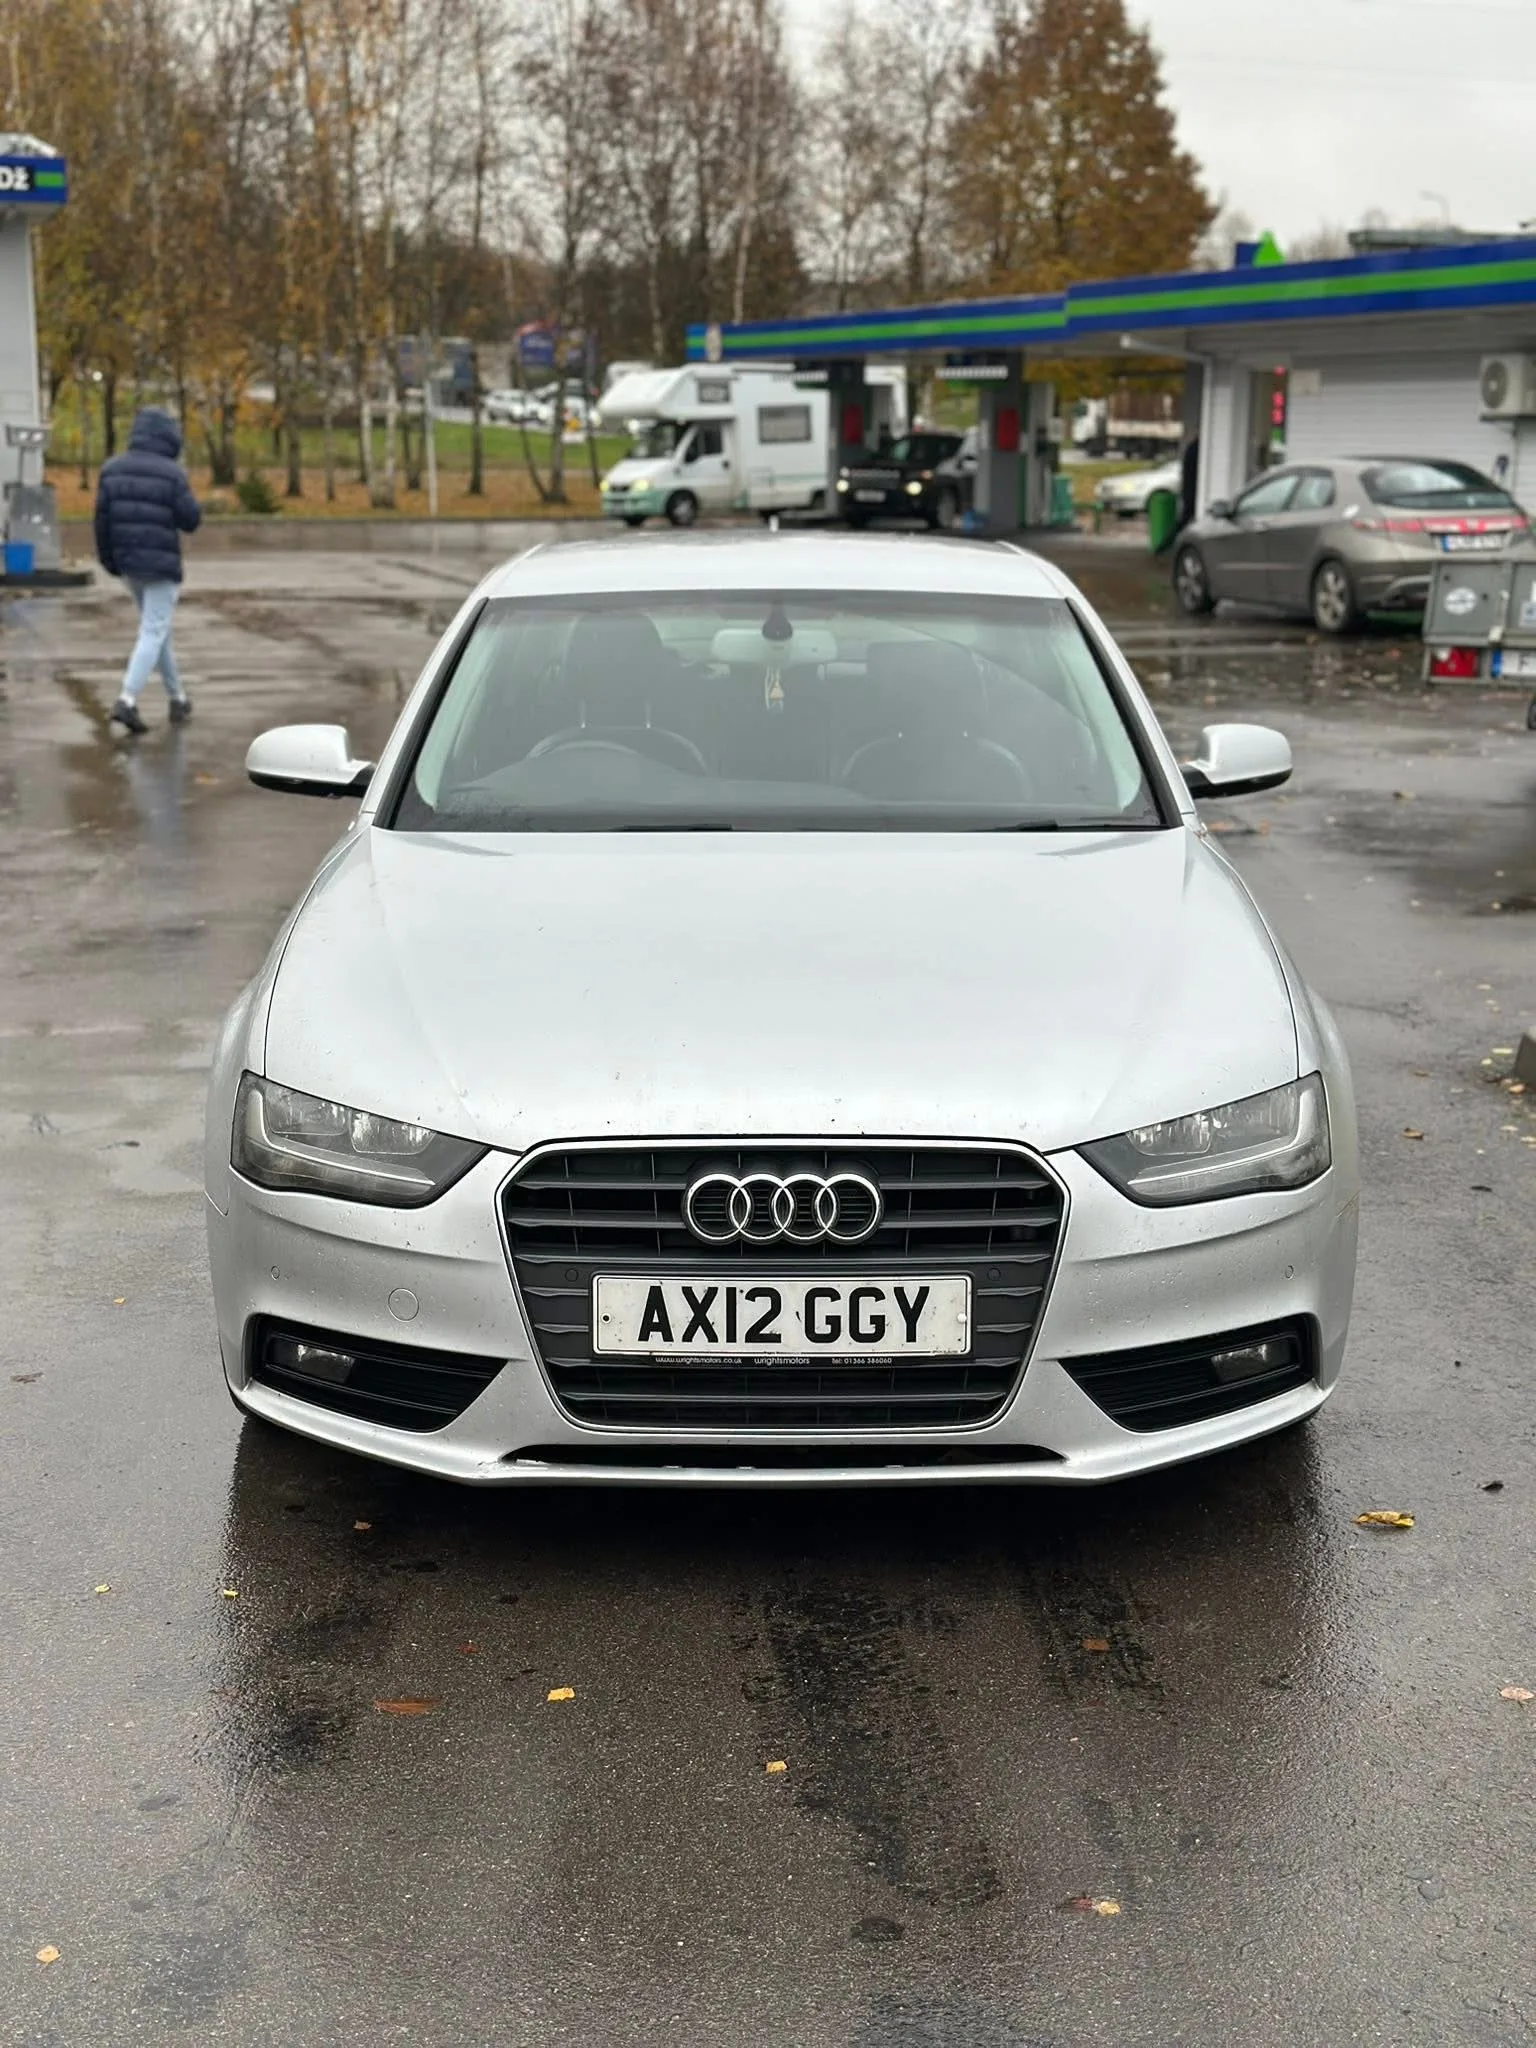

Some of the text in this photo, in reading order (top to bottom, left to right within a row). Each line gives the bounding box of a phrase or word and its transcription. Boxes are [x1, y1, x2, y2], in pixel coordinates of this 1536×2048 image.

[637, 1285, 931, 1344] AX12 GGY
[655, 1356, 742, 1365] www.wrightsmotors.co.uk
[754, 1356, 811, 1367] wrightsmotors
